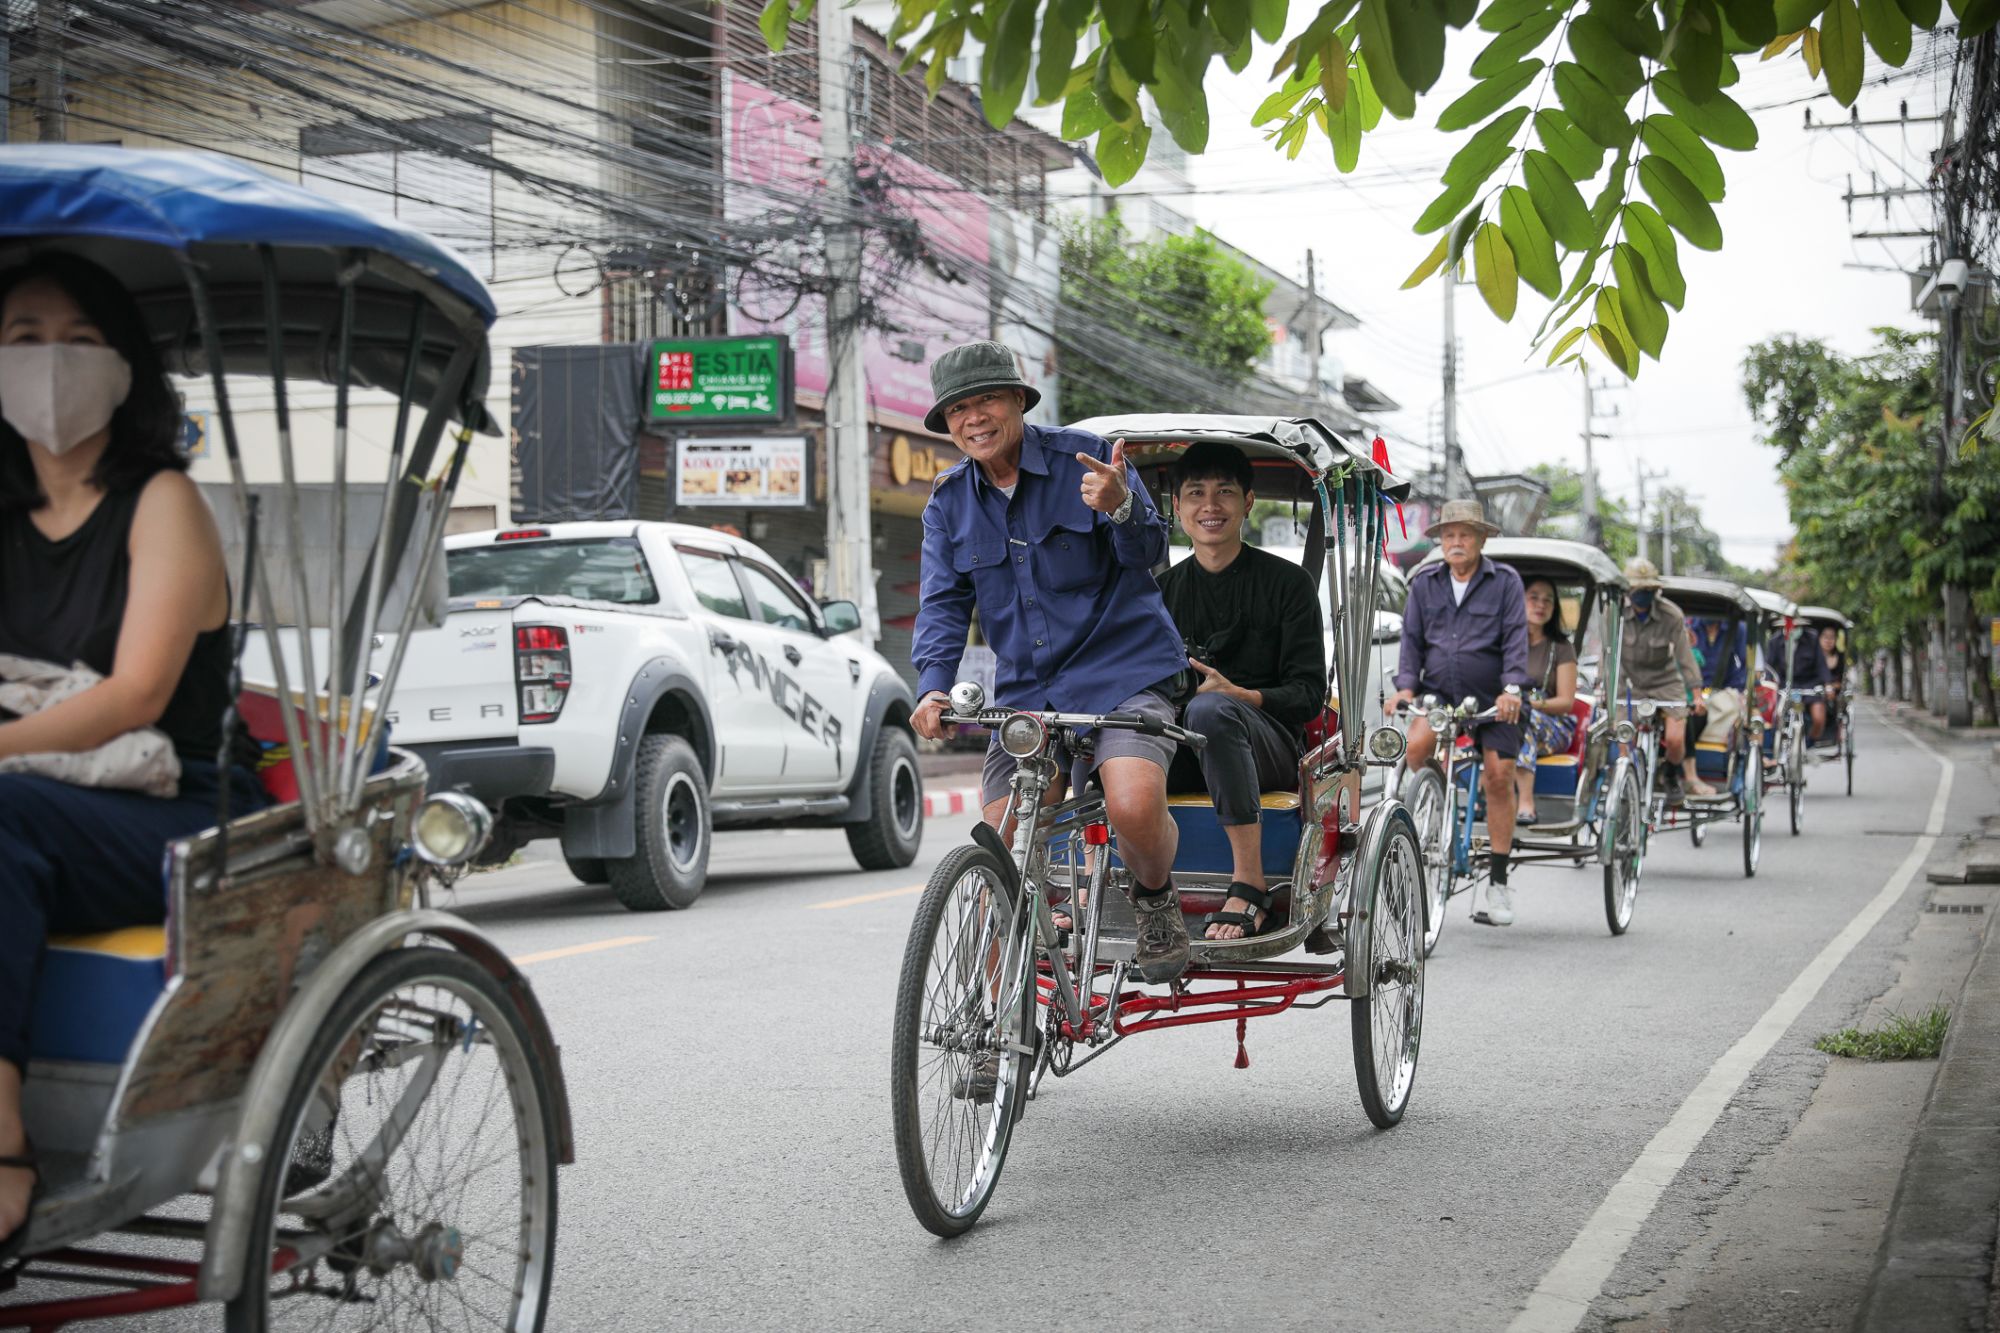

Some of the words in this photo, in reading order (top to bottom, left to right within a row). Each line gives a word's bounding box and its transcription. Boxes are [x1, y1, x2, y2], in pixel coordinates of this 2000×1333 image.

[695, 352, 774, 375] ESTIA
[698, 375, 747, 386] CHIANG
[683, 457, 724, 469] KOKO
[730, 457, 770, 470] PALM
[775, 456, 800, 468] INN
